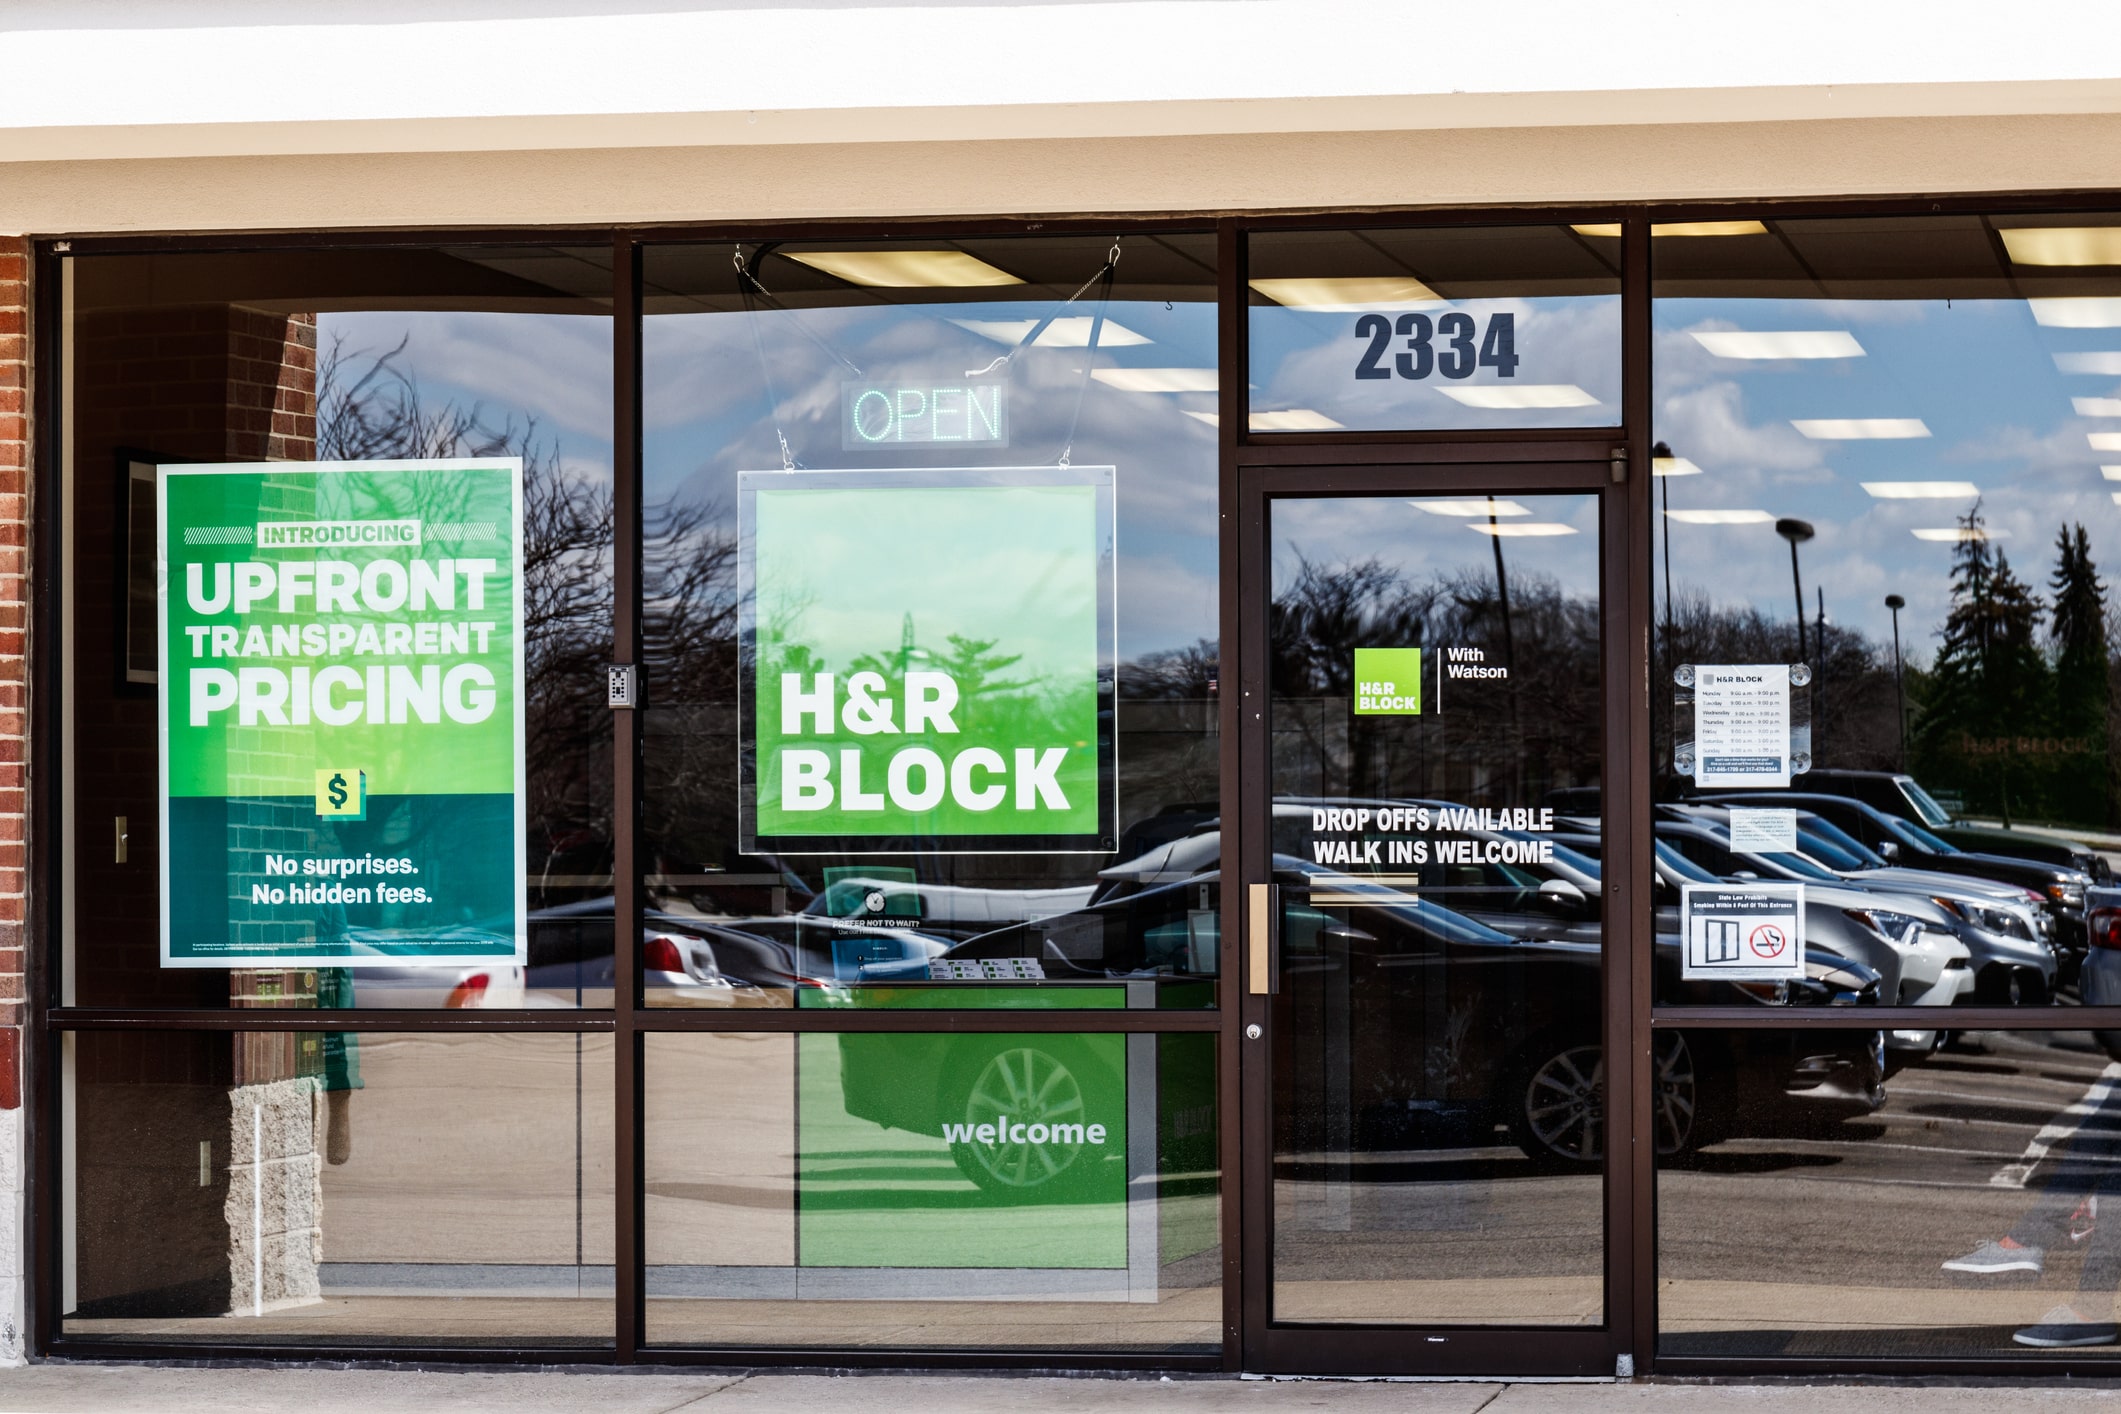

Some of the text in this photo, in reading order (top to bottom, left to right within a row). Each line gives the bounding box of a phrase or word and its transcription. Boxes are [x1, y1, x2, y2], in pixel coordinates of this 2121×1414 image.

[1355, 312, 1519, 380] 2334
[853, 387, 998, 441] OPEN
[263, 524, 415, 544] INTRODUCING
[186, 558, 496, 615] UPFRONT
[185, 622, 496, 657] TRANSPARENT
[1447, 647, 1484, 662] With
[1447, 664, 1508, 679] Watson
[189, 663, 496, 727] PRICING
[1359, 682, 1395, 695] H&R
[781, 671, 960, 735] H&R
[1359, 697, 1416, 710] BLOCK
[328, 773, 348, 809] $
[781, 746, 1072, 812] BLOCK
[1313, 808, 1553, 831] DROP OFFS AVAILABLE
[1313, 841, 1554, 864] WALK INS WELCOME
[265, 853, 419, 879] No surprises.
[252, 882, 432, 905] No hidden fees.
[833, 920, 866, 928] PREFER
[896, 920, 919, 928] WAIT?
[941, 1116, 1107, 1144] welcome
